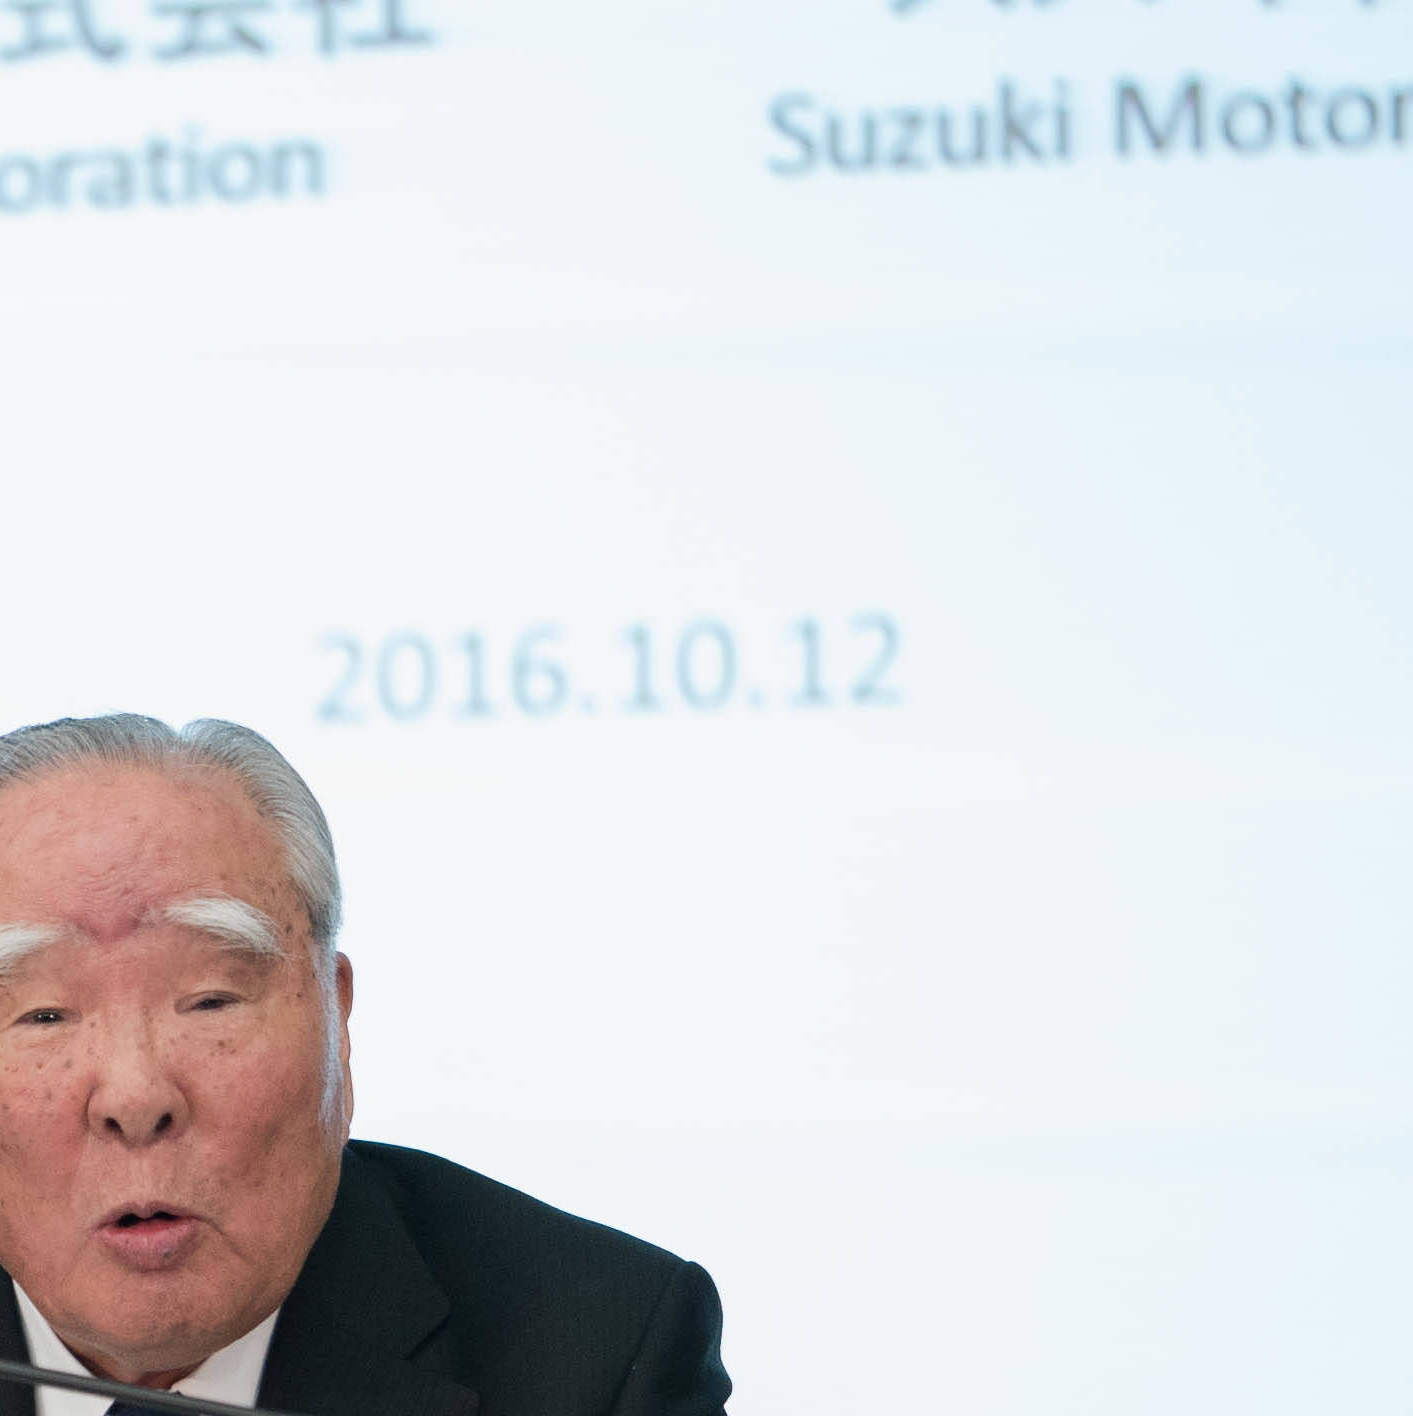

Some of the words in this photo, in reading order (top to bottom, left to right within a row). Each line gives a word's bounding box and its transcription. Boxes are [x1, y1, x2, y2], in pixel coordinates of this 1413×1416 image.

[768, 78, 1075, 175] Suzuki
[1115, 74, 1413, 157] Motor
[315, 609, 903, 724] 2016.10.12
